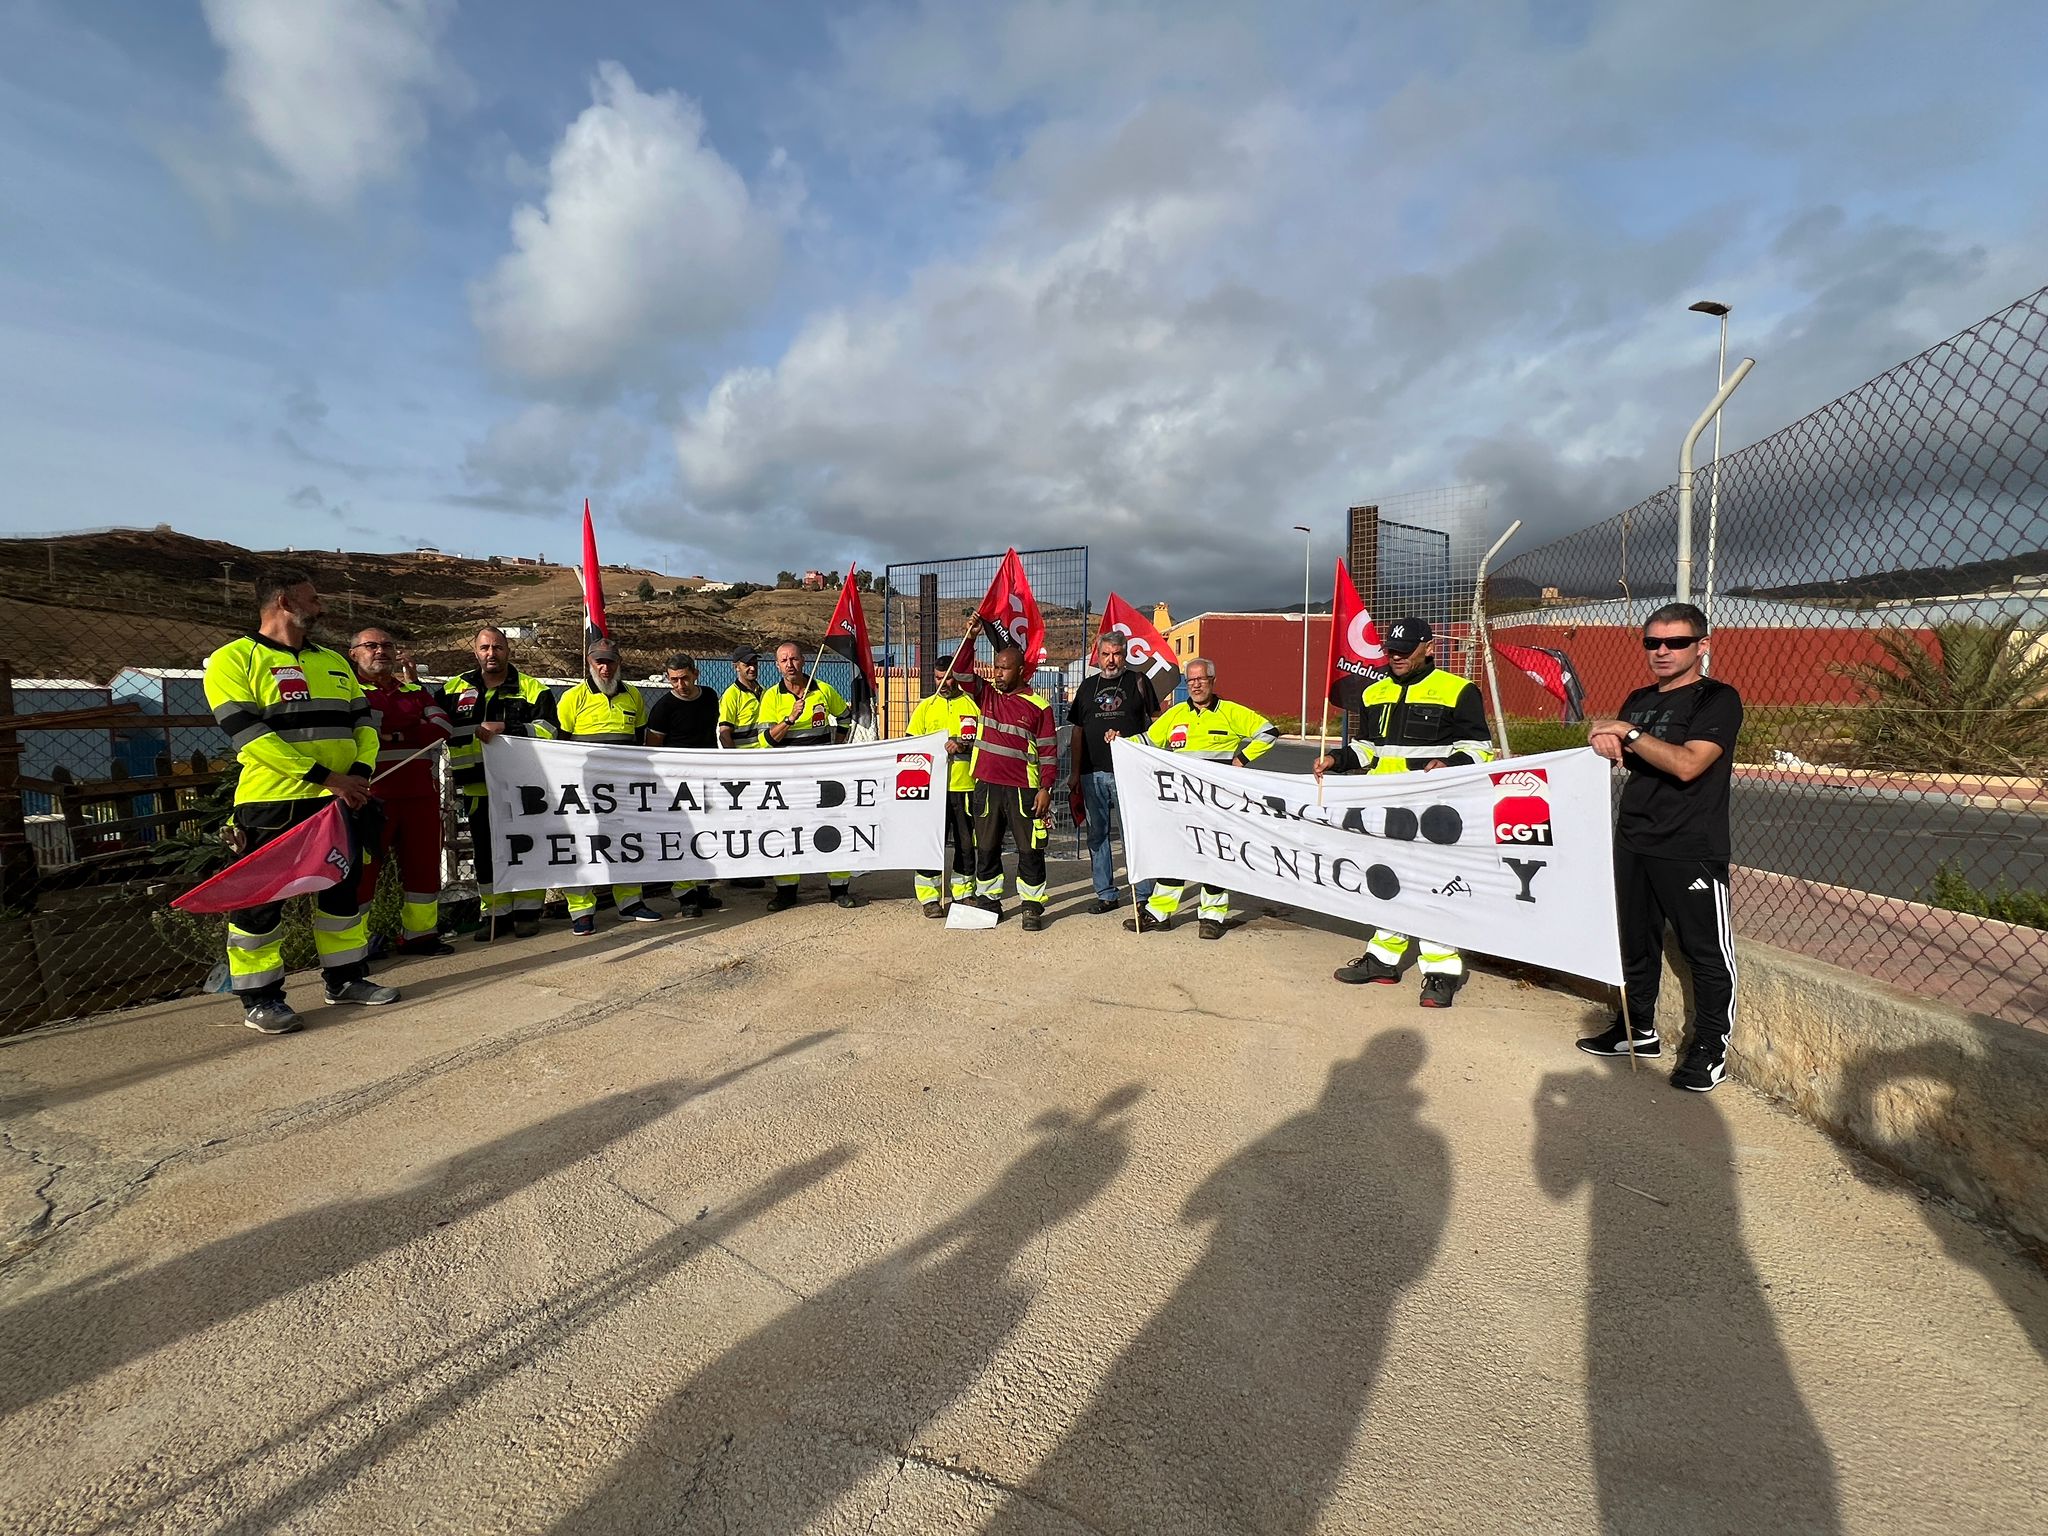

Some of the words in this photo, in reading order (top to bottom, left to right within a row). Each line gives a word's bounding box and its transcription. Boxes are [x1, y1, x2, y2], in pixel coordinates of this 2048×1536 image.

[282, 690, 309, 701] CGT
[457, 704, 475, 712] CGT
[812, 719, 825, 727] CGT
[1170, 740, 1187, 748] CGT
[719, 780, 790, 811] YA
[816, 779, 879, 809] DE
[896, 785, 929, 799] CGT
[1496, 823, 1550, 842] CGT
[507, 824, 879, 866] PERSECUCION
[1185, 825, 1401, 900] TECNICO
[1501, 857, 1548, 904] Y
